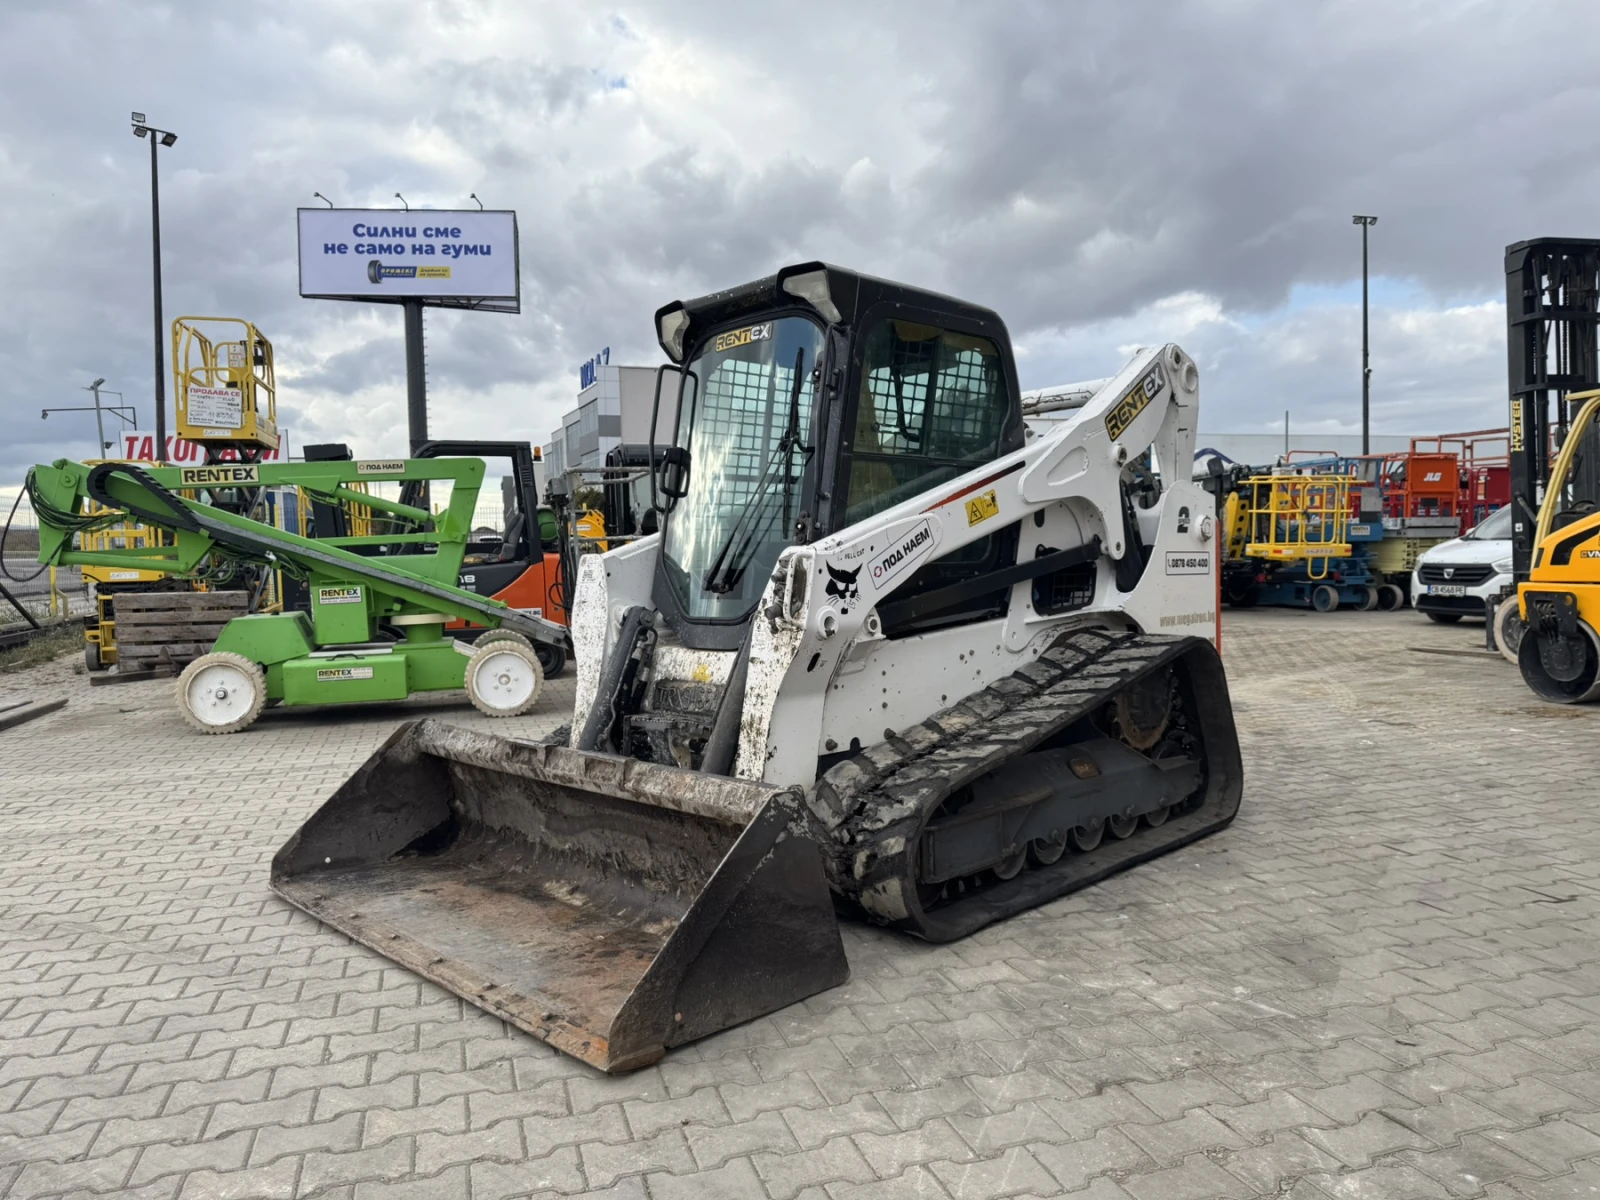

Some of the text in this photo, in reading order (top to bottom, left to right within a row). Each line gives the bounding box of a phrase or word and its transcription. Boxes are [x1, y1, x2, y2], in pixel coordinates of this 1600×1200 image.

[353, 223, 462, 238] Силни сме
[324, 243, 492, 258] не само на гуми
[717, 324, 770, 349] RENTEX
[190, 388, 230, 396] ПРОДАВА
[1107, 367, 1163, 437] RENTEX
[1512, 400, 1522, 452] HYSTER
[383, 463, 404, 471] НАЕМ
[184, 468, 255, 482] RENTEX
[1424, 472, 1442, 482] JLG
[882, 527, 930, 573] ПОД НАЕМ
[1171, 558, 1208, 568] 0878 450 400
[321, 588, 358, 597] RENTEX
[318, 669, 352, 677] RENTEX
